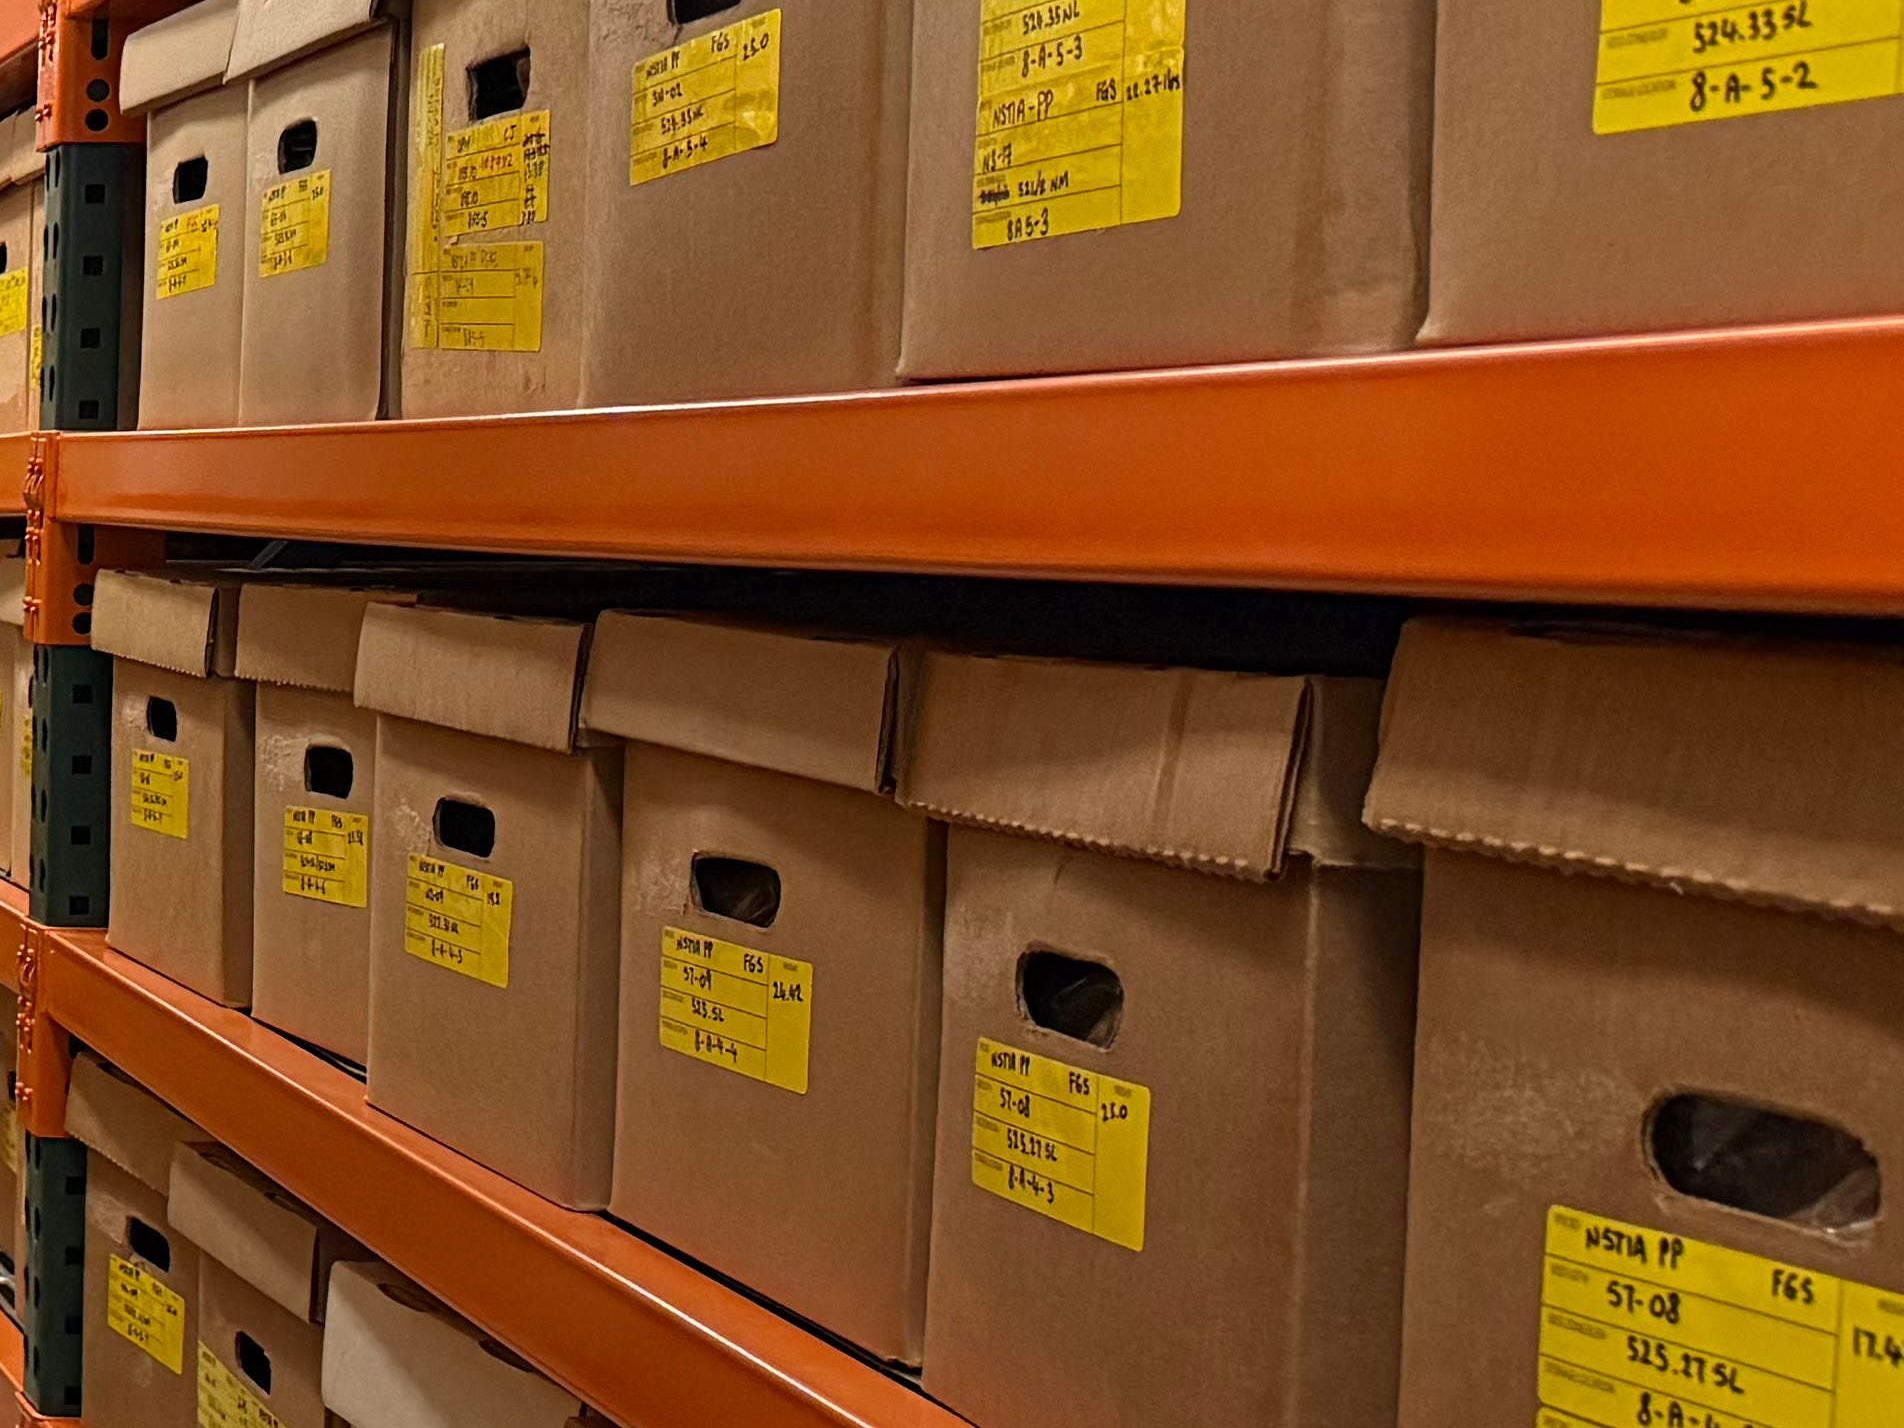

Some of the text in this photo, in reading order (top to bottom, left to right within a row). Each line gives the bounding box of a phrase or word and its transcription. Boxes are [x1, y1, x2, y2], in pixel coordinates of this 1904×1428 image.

[743, 953, 765, 974] FGS
[1069, 1071, 1091, 1097] FGS
[1585, 1225, 1816, 1308] NSTIA PP FGS
